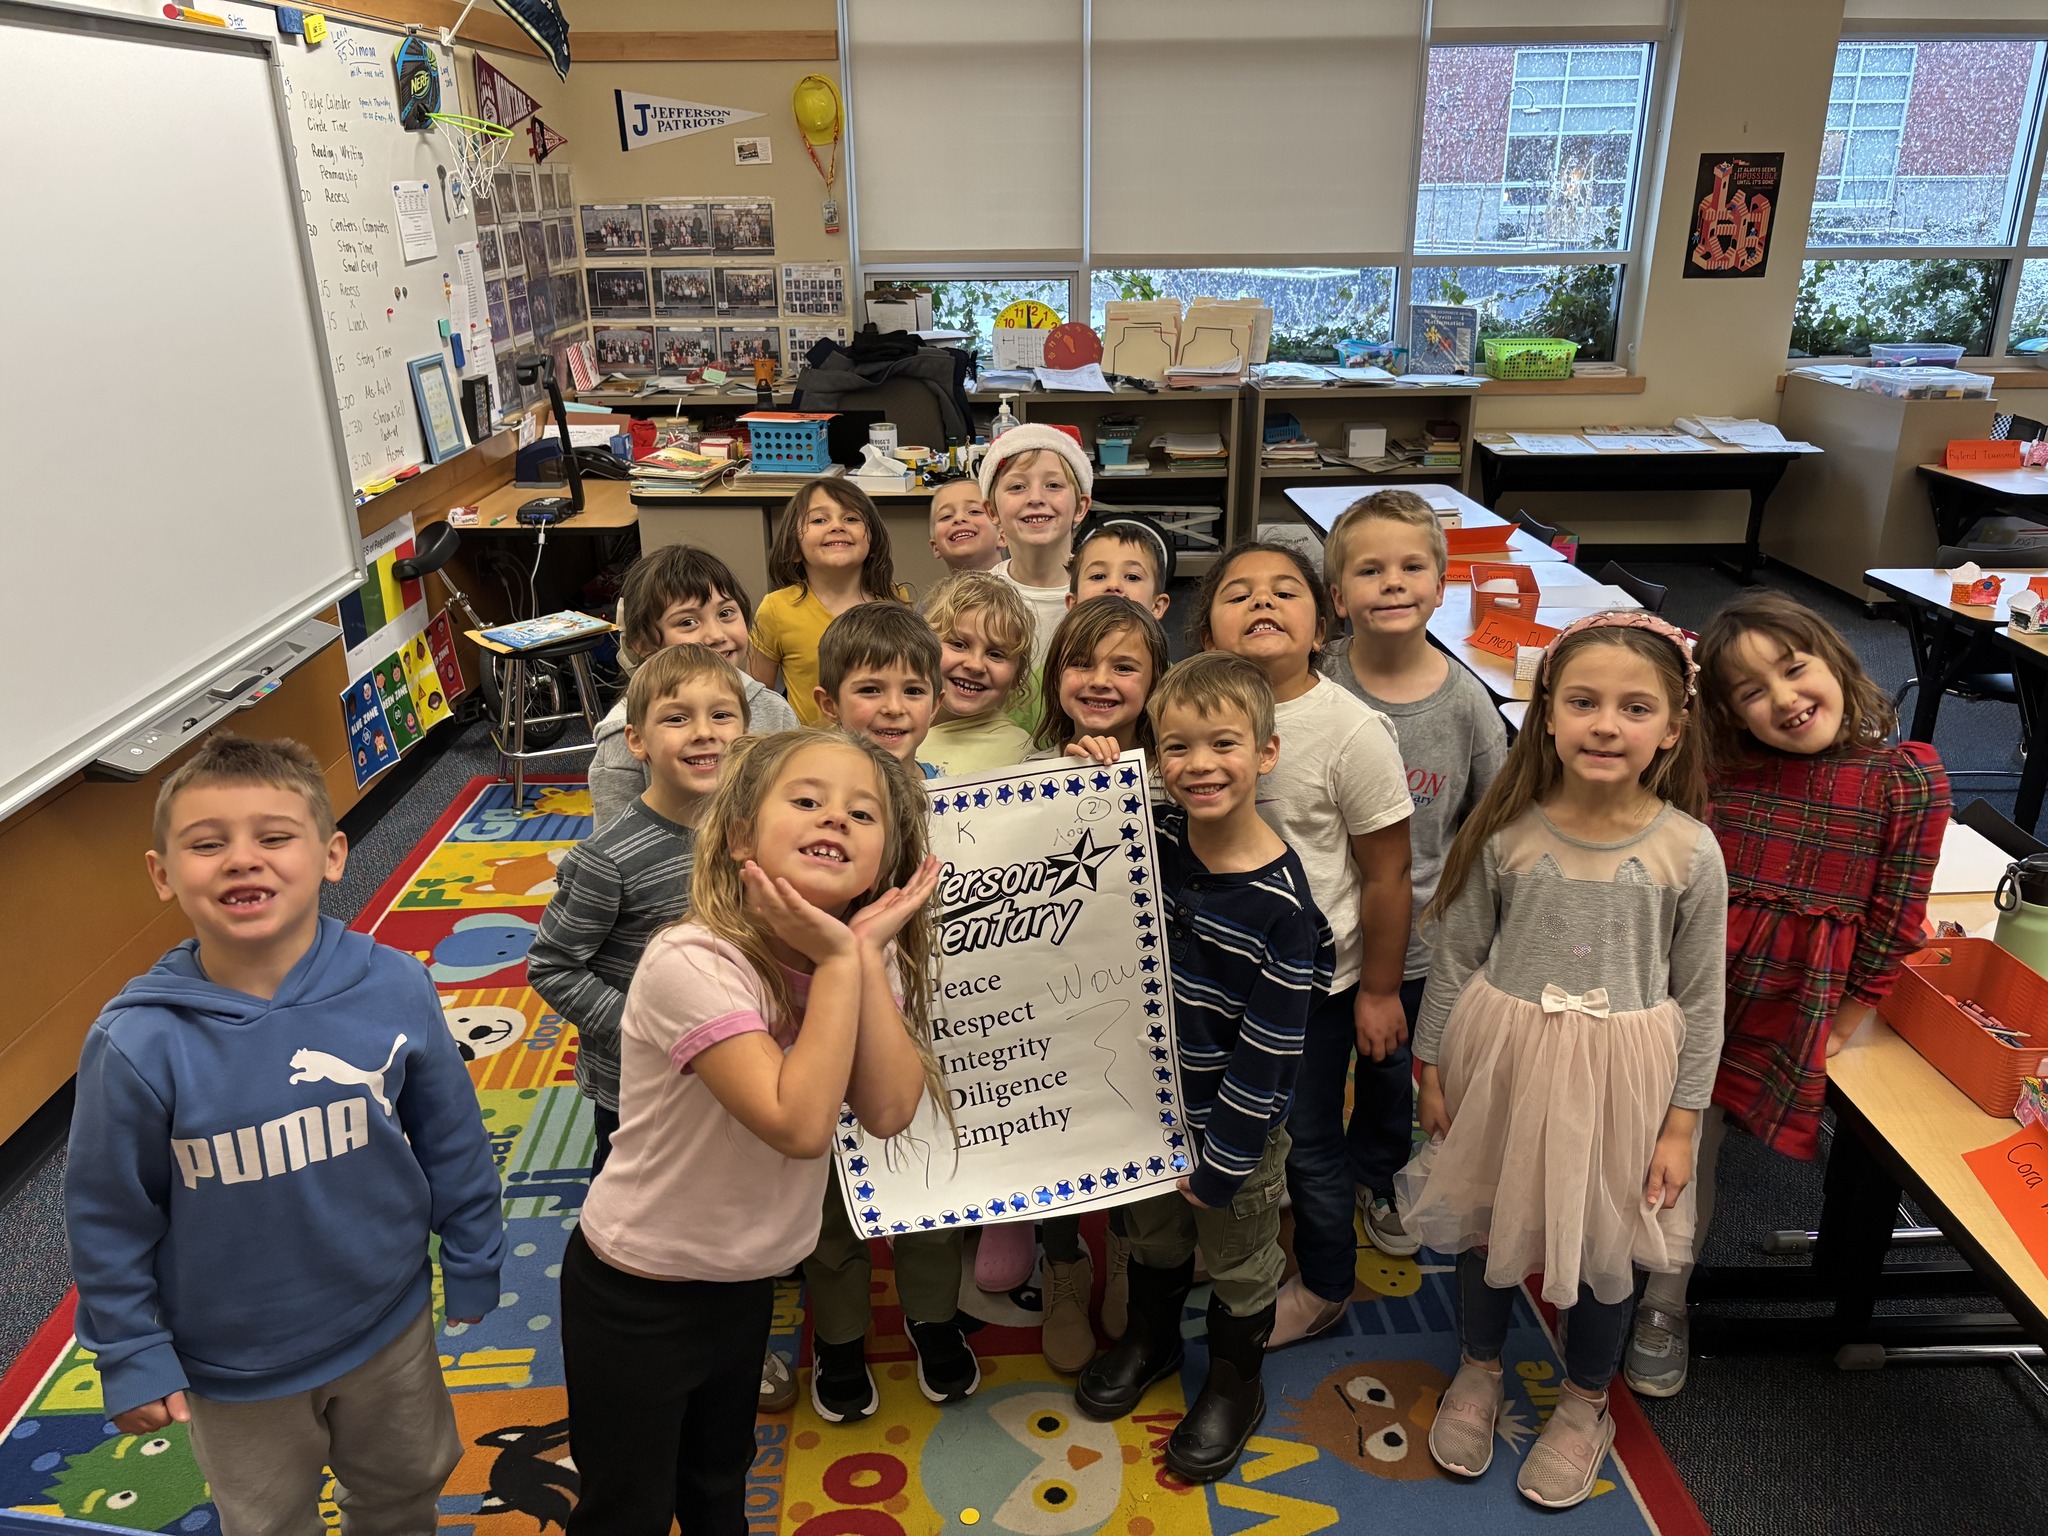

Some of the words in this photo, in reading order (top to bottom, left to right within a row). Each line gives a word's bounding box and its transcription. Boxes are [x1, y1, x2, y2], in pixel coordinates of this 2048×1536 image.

[411, 72, 429, 94] NERF
[632, 104, 651, 136] J
[651, 107, 731, 119] JEFFERSON
[307, 117, 328, 132] Circle
[332, 120, 348, 132] Time
[657, 118, 725, 132] PATRIOTS
[339, 145, 364, 167] Writing
[319, 164, 358, 189] Penmanship
[325, 187, 350, 203] Recess
[362, 218, 390, 239] Computers
[337, 239, 357, 258] Story
[358, 241, 374, 255] Time
[342, 259, 359, 272] Small
[340, 283, 360, 297] Recess
[347, 312, 368, 331] Lunch
[1003, 318, 1015, 329] 10
[1014, 308, 1024, 318] 11
[1043, 311, 1048, 321] 1
[356, 351, 375, 368] Story
[376, 346, 392, 360] Time
[352, 453, 372, 471] 3:00
[386, 445, 405, 463] Home
[368, 540, 374, 553] of
[374, 531, 397, 550] Regulation
[1477, 621, 1516, 657] Emery
[382, 694, 395, 711] REEN
[394, 684, 409, 701] ZONE
[351, 717, 363, 736] BLUE
[363, 705, 379, 725] ZONE
[957, 820, 976, 844] K
[1046, 962, 1136, 1005] Wow
[930, 1001, 1036, 1042] Respect
[937, 1037, 1052, 1076] Integrity
[946, 1069, 1068, 1111] Diligence
[950, 1105, 1072, 1151] Empathy
[171, 1097, 369, 1190] PUMA
[2007, 1142, 2043, 1189] Cora
